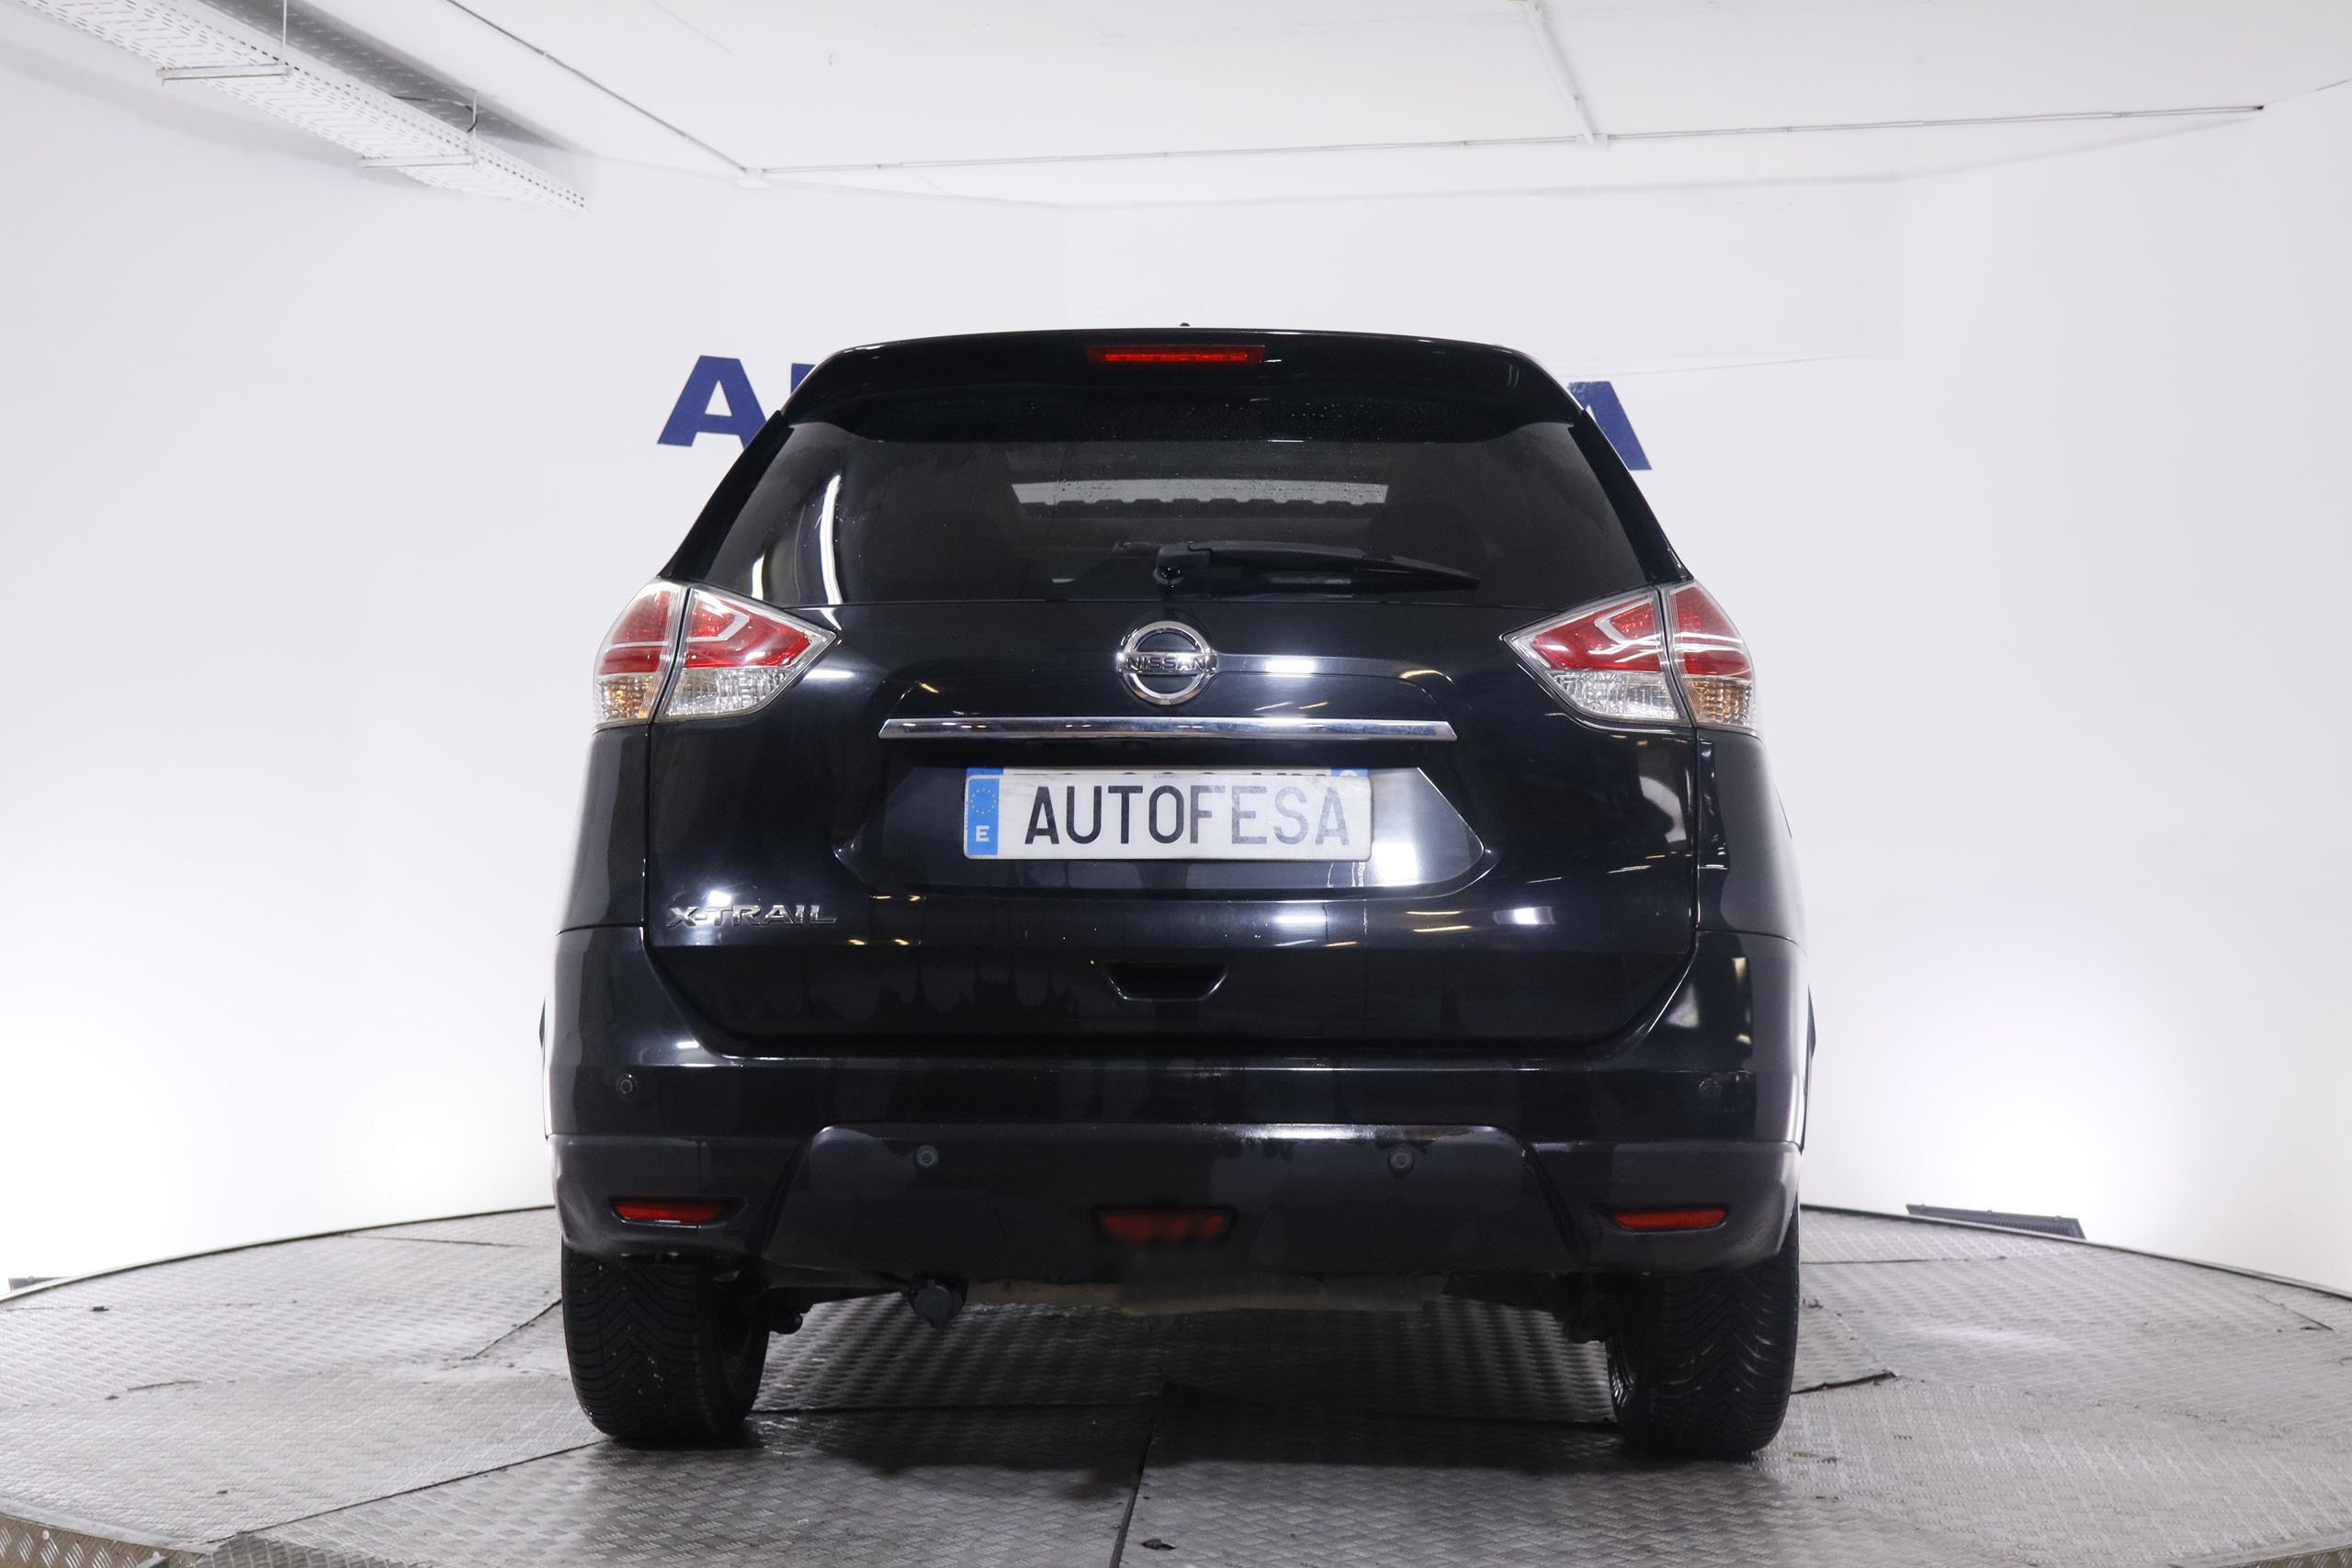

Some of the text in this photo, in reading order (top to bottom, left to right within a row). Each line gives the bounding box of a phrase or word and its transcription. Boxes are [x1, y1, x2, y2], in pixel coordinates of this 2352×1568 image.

[1125, 655, 1207, 671] NISSAN
[1024, 784, 1350, 846] AUTOFESA
[976, 825, 990, 842] E
[666, 904, 838, 928] X-TRAIL
